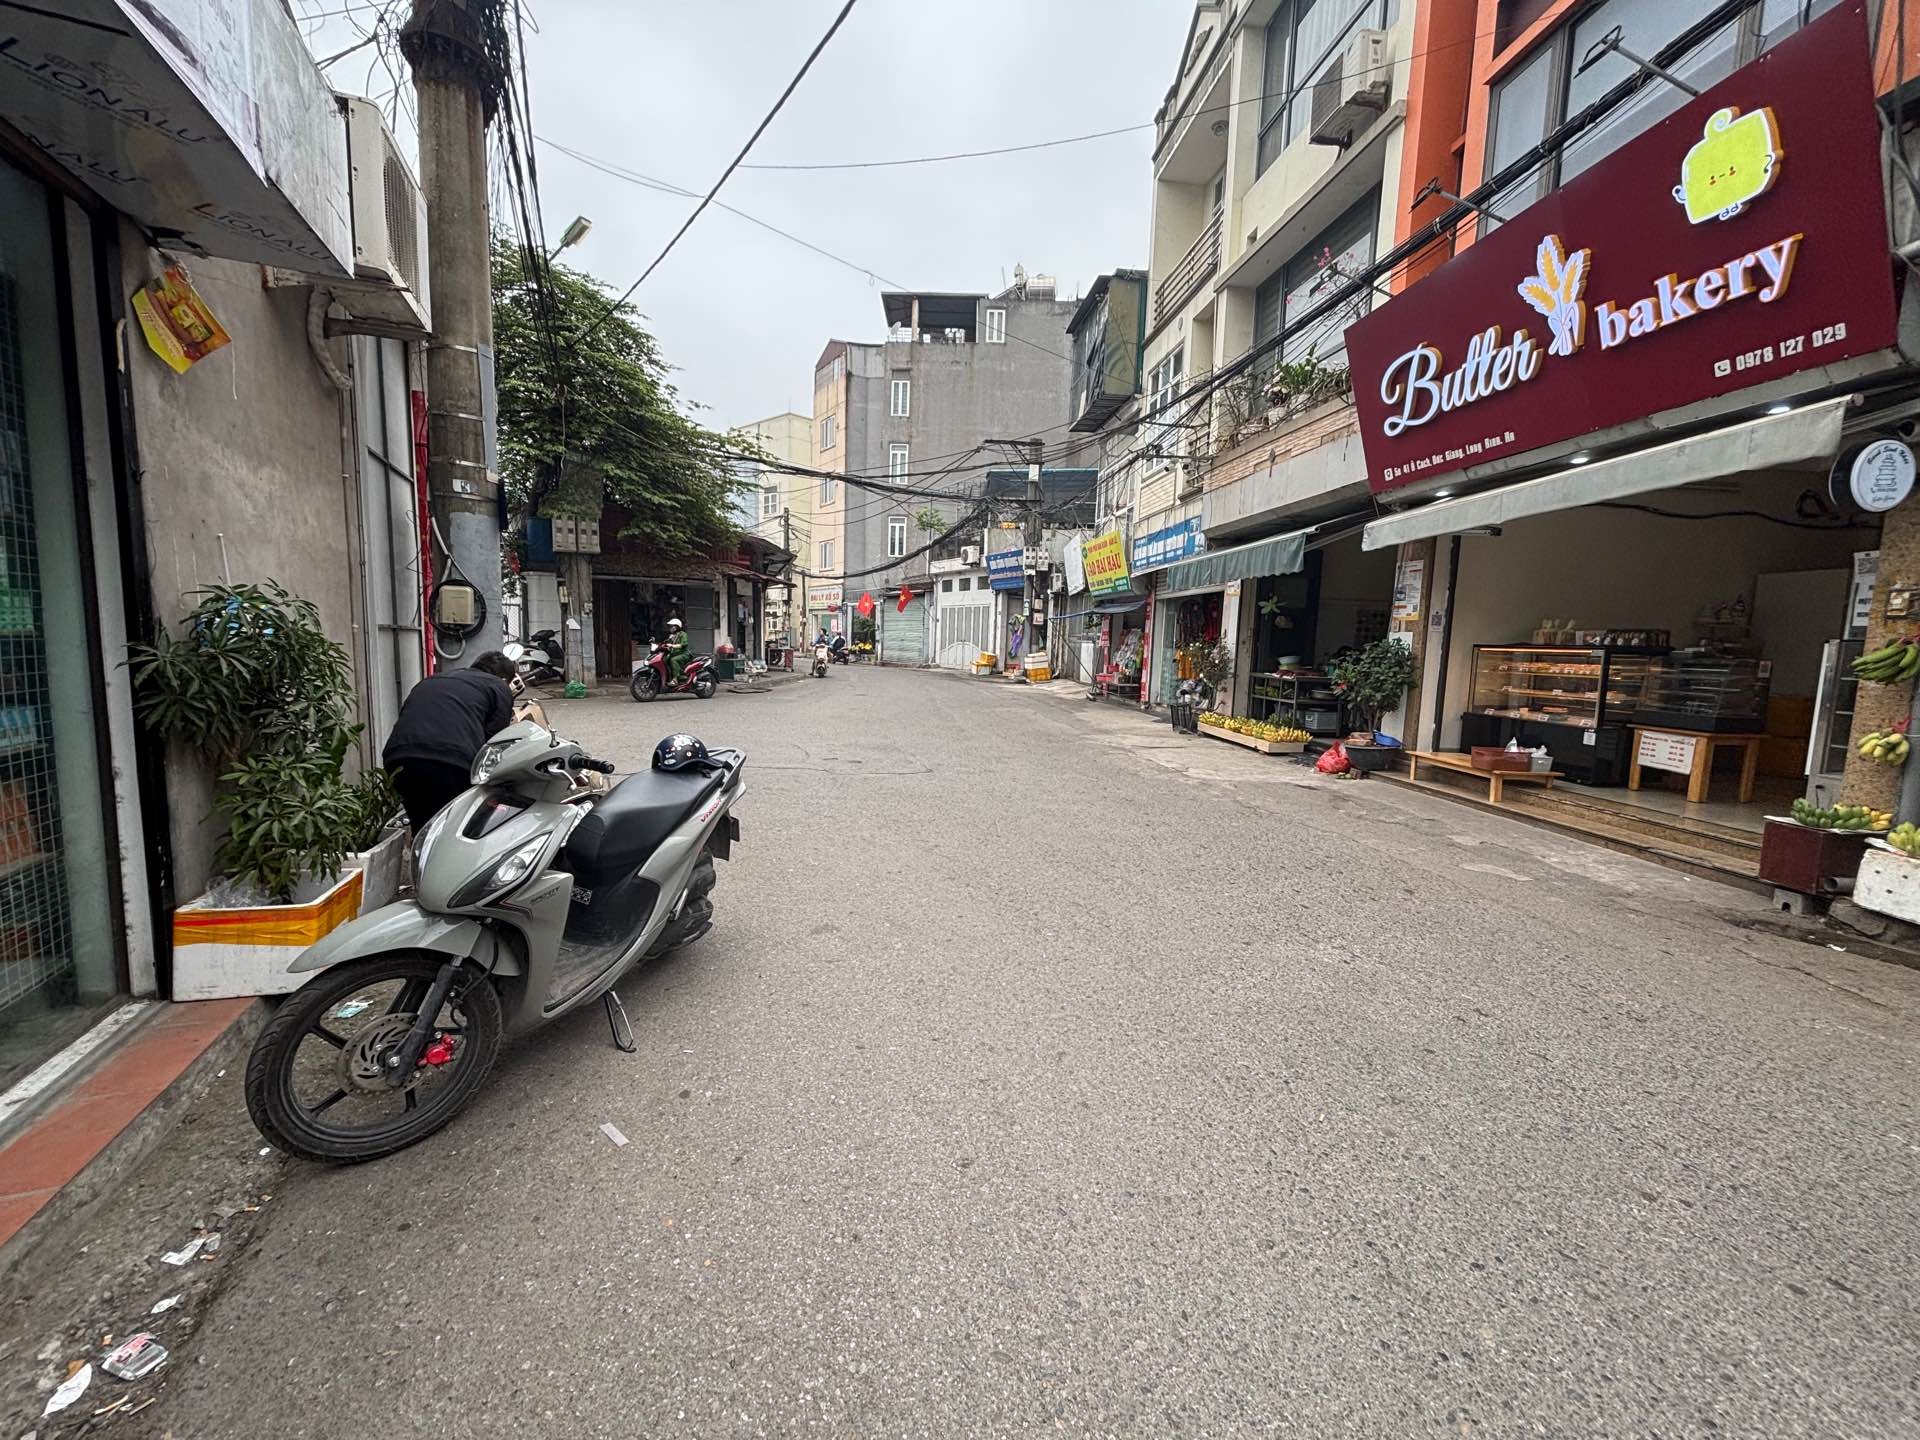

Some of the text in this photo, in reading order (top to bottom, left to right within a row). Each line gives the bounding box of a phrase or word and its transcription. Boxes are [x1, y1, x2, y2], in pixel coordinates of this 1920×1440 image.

[193, 203, 331, 260] LIONALU
[1381, 233, 1803, 438] Butter bakery
[1735, 322, 1847, 371] 0978 127 029
[1466, 442, 1483, 455] Long
